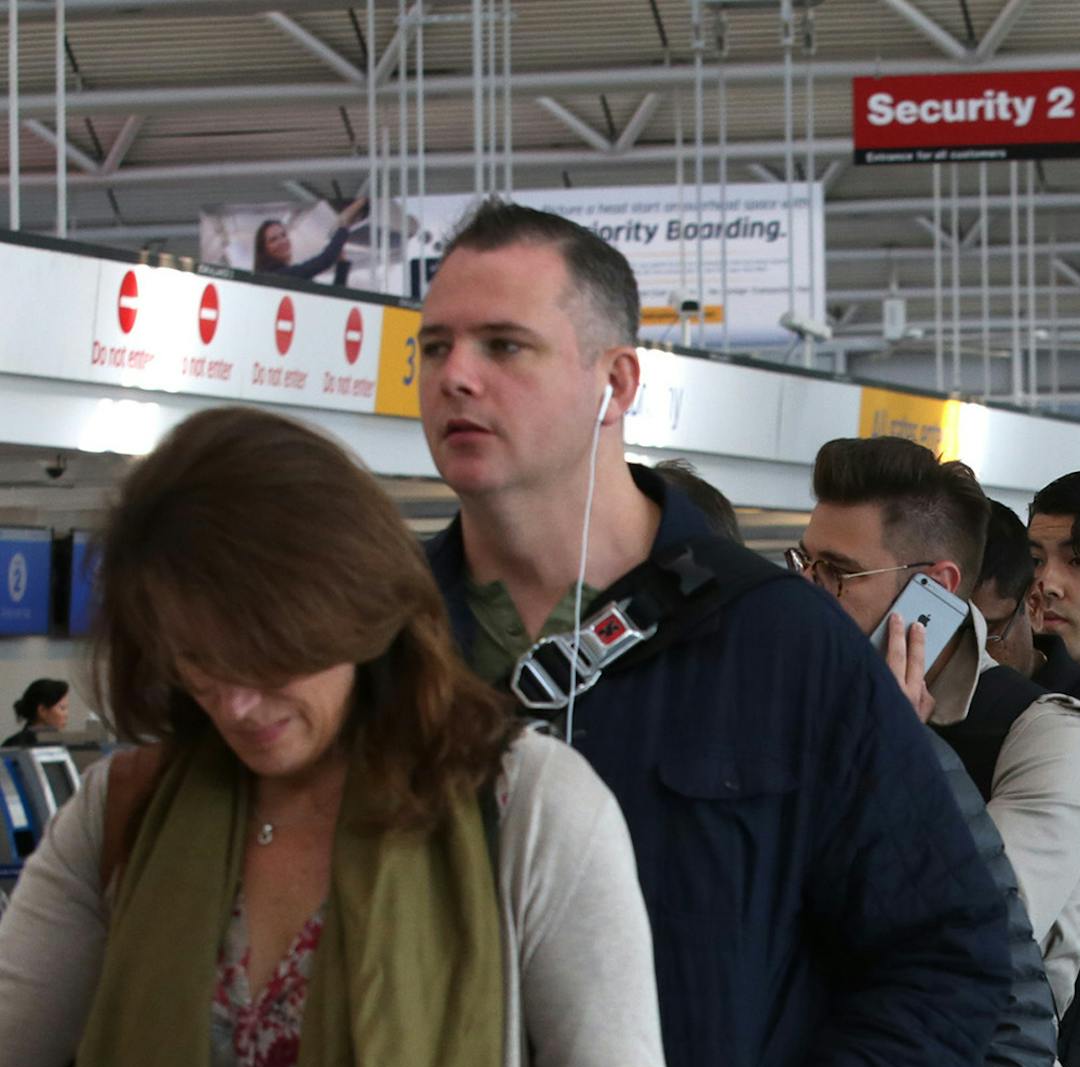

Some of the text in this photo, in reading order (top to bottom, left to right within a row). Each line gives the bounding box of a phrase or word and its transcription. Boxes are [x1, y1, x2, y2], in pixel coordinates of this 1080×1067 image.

[867, 86, 1075, 127] Security 2
[865, 148, 1007, 163] Entrance for all customers
[590, 216, 787, 245] iority Boarding.
[91, 340, 107, 365] Do
[109, 346, 126, 368] not
[190, 356, 206, 377] not
[207, 359, 234, 381] enter
[252, 361, 307, 389] Do not enter
[323, 371, 375, 397] Do not enter
